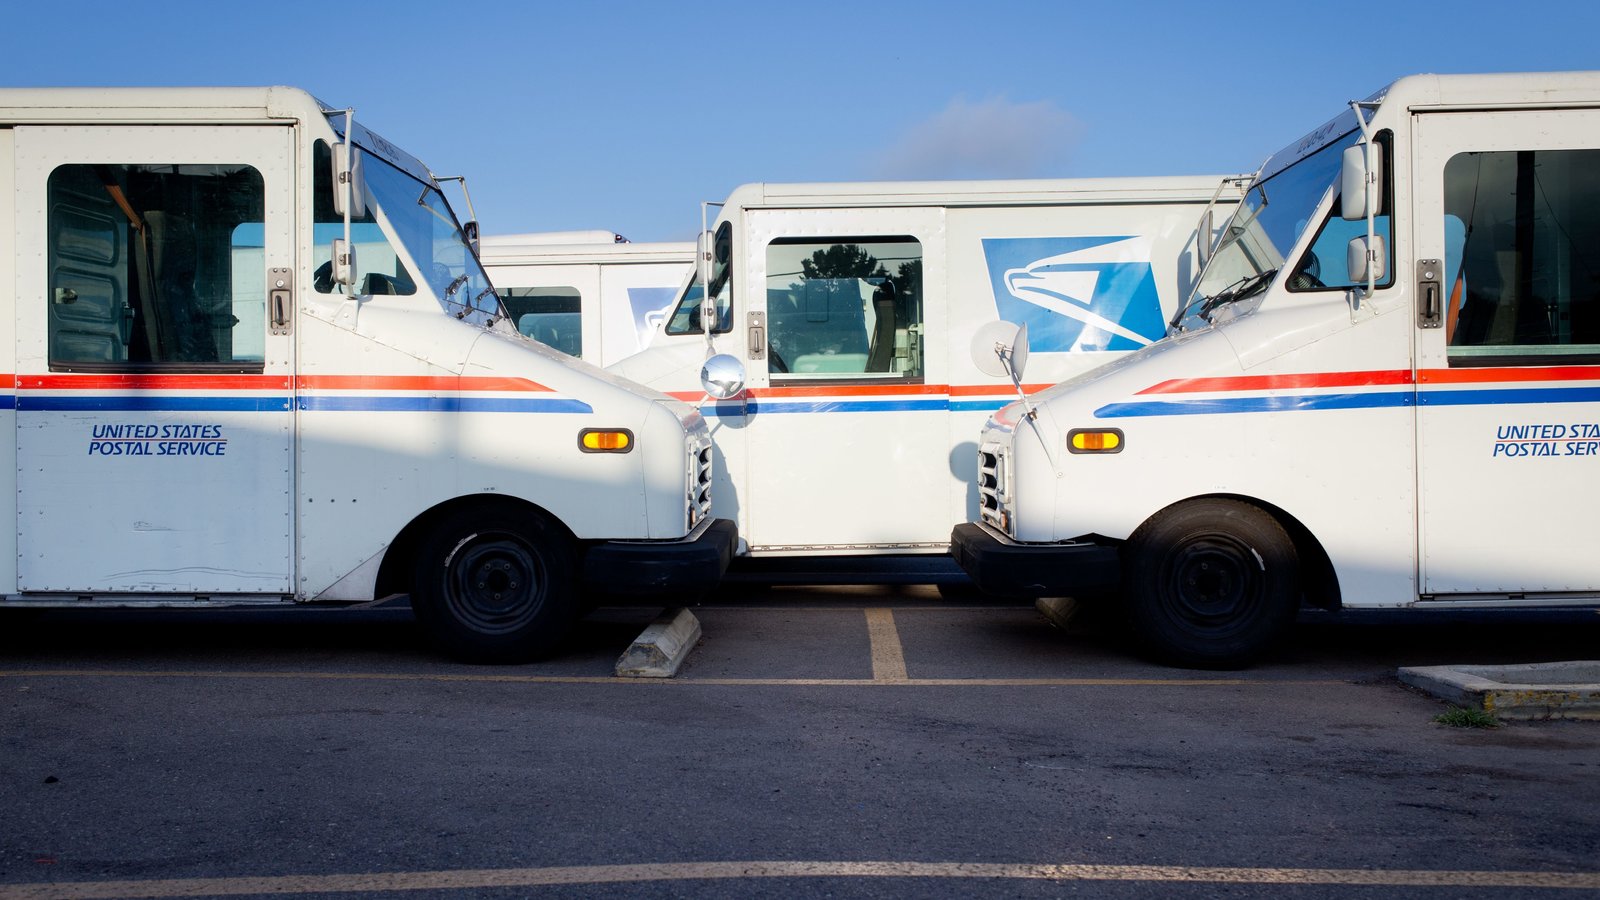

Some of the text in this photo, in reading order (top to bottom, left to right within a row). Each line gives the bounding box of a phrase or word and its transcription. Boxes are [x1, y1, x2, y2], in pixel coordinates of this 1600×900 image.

[92, 424, 222, 439] UNITED STATES
[1497, 424, 1566, 440] UNITED
[88, 441, 228, 456] POSTAL SERVICE
[1492, 441, 1600, 457] POSTAL SER
